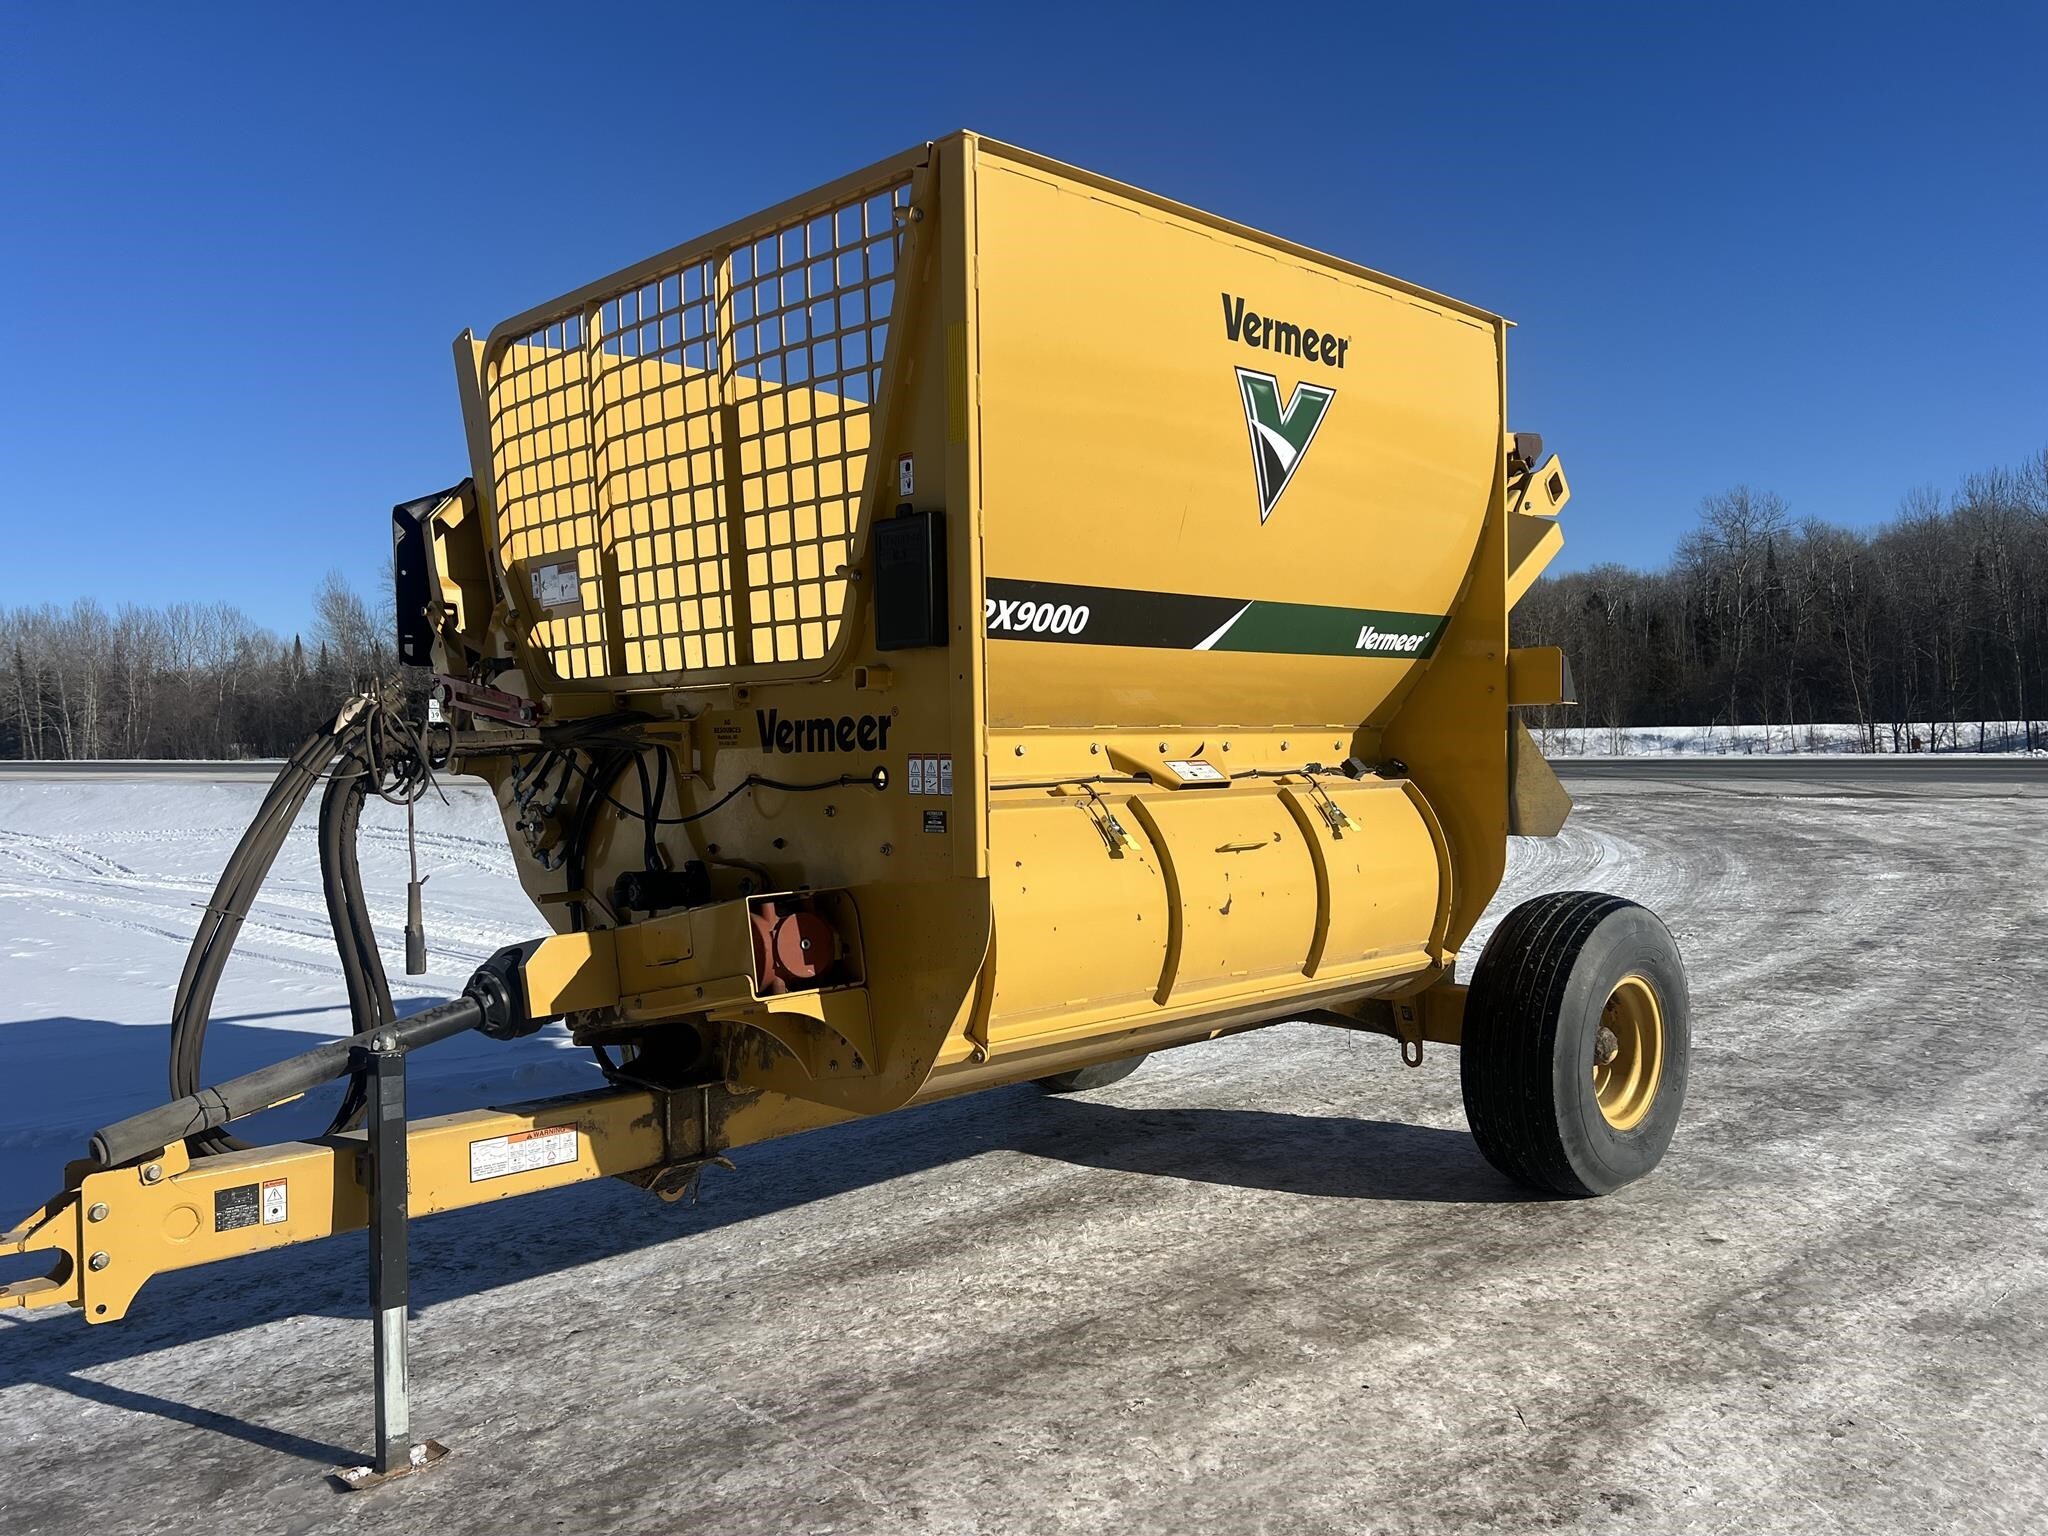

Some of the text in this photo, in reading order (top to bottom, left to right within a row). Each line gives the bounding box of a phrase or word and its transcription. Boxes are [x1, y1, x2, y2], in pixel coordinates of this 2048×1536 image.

[1221, 292, 1349, 369] Vermeer
[1355, 625, 1426, 652] Vermeer
[756, 708, 892, 754] Vermeer
[533, 1127, 565, 1138] WARNING
